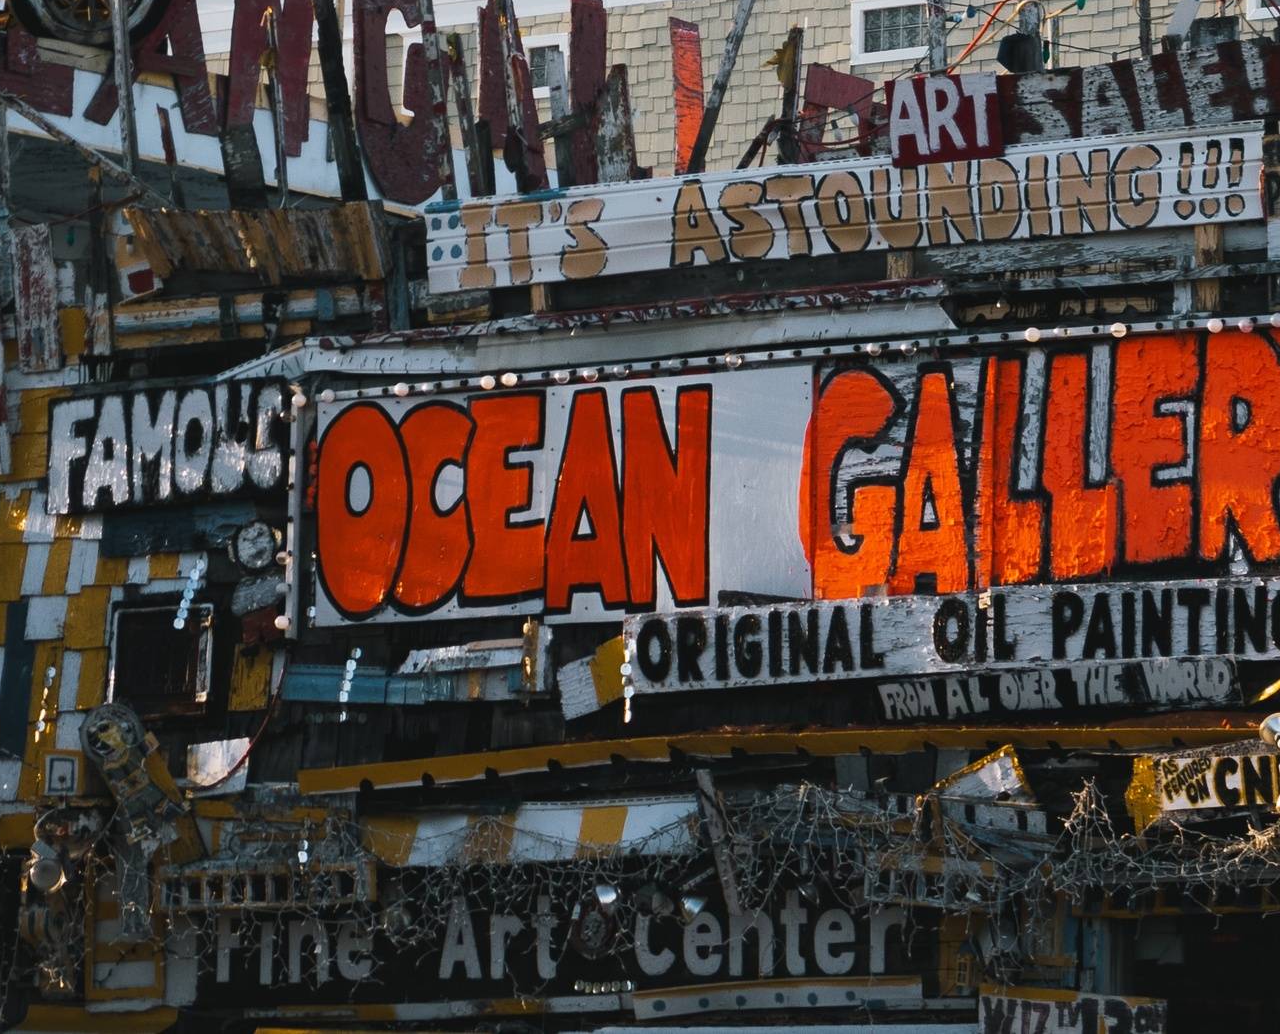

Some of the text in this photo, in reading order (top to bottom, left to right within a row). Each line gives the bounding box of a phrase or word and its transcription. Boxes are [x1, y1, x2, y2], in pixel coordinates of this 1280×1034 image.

[890, 40, 1266, 160] ART SALE!
[458, 199, 607, 289] IT'S
[47, 382, 284, 515] FAMOUS
[314, 381, 713, 623] OCEAN
[635, 603, 885, 685] ORIGINAL
[931, 591, 1017, 663] OIL
[877, 682, 940, 721] FROM
[998, 671, 1064, 711] OVER
[1071, 663, 1124, 706] THE
[1140, 656, 1232, 705] WORLD
[1162, 758, 1180, 780] AS
[1163, 758, 1213, 803] FEATURED
[1185, 778, 1210, 804] ON
[1214, 755, 1280, 807] CN
[440, 895, 559, 981] Art
